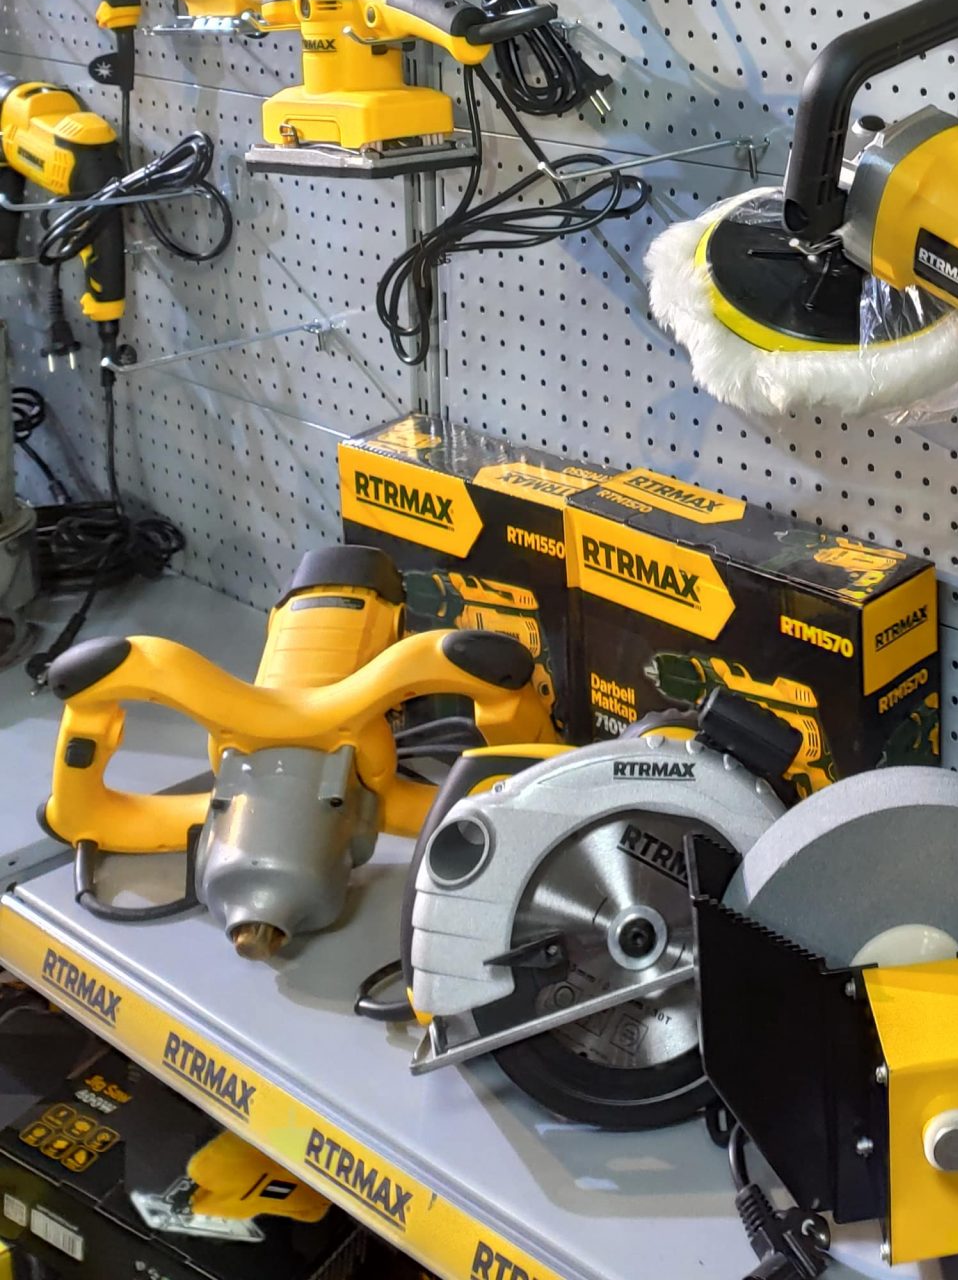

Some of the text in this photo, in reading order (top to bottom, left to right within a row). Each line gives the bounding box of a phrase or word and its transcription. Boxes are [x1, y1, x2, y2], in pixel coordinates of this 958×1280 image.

[354, 470, 454, 526] RTRMAX
[627, 475, 724, 514] RTRMAX
[507, 524, 565, 560] RTM1550
[582, 534, 700, 603] RTRMAX
[779, 615, 854, 659] RTM1570
[875, 604, 928, 650] RTRMAX
[592, 689, 638, 724] Matkap
[614, 760, 696, 779] RTRMAX
[618, 824, 688, 882] RTRM
[42, 948, 122, 1022] RTRMAX
[163, 1031, 257, 1115] RTRMAX
[305, 1128, 413, 1224] RTRMAX
